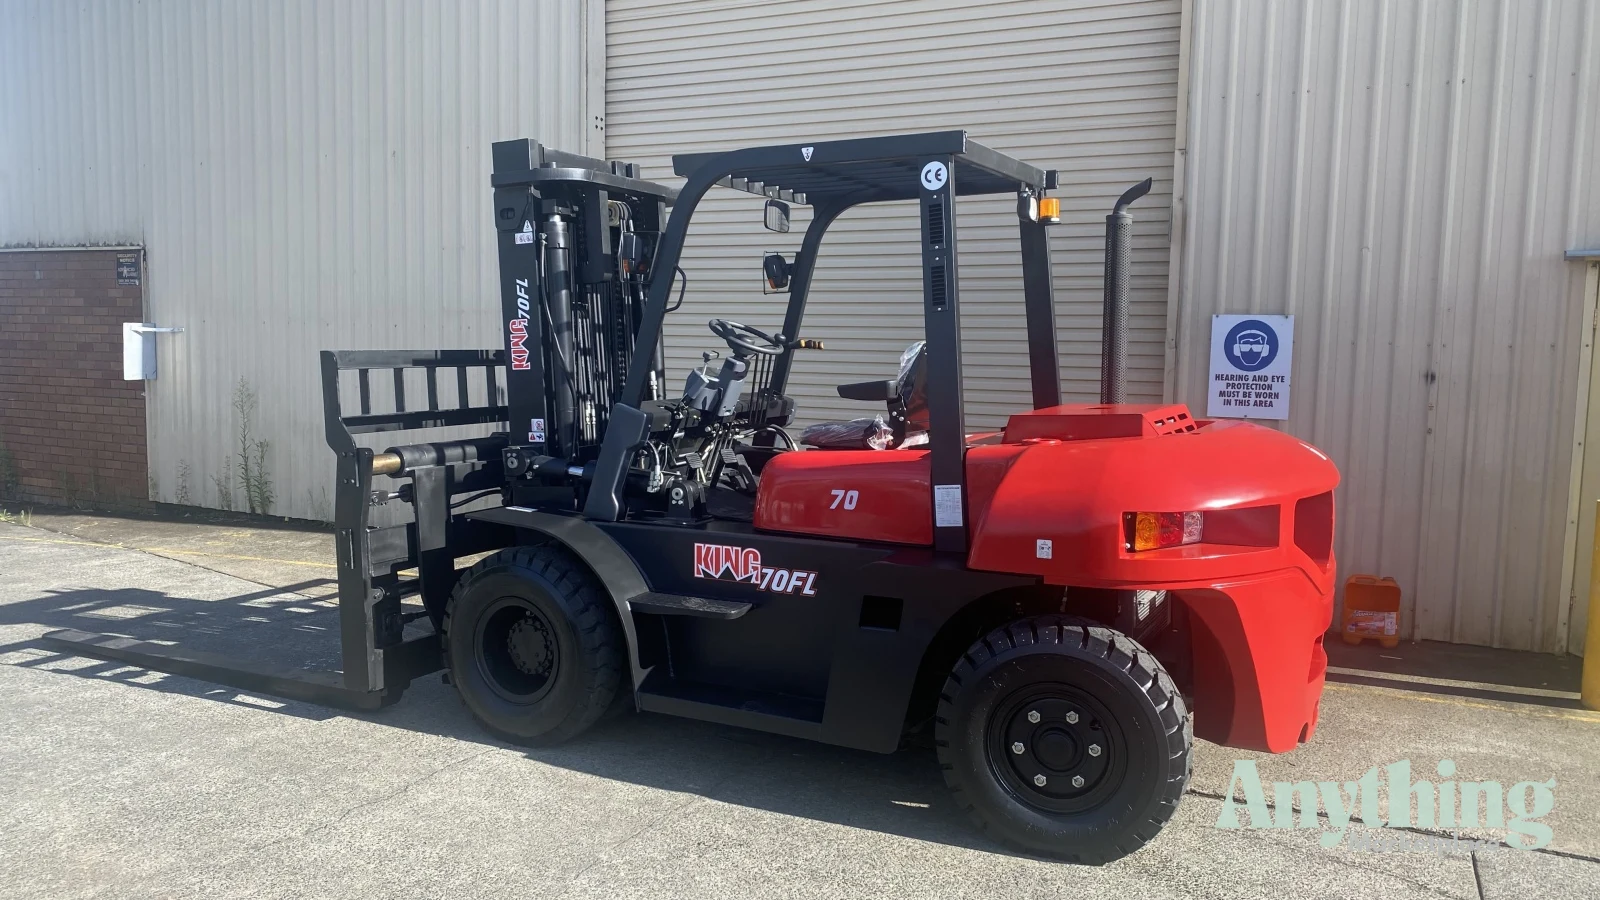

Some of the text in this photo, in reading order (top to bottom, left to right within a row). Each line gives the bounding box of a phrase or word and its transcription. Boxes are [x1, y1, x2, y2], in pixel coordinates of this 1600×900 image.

[509, 278, 531, 370] KING 70FL
[1214, 373, 1285, 383] HEARING AND EYE
[1225, 382, 1273, 391] PROTECTION
[1218, 390, 1280, 400] MUST BE WORN
[1223, 398, 1274, 408] IN THIS AREA
[829, 489, 859, 510] 70
[694, 542, 817, 596] KING 70FL
